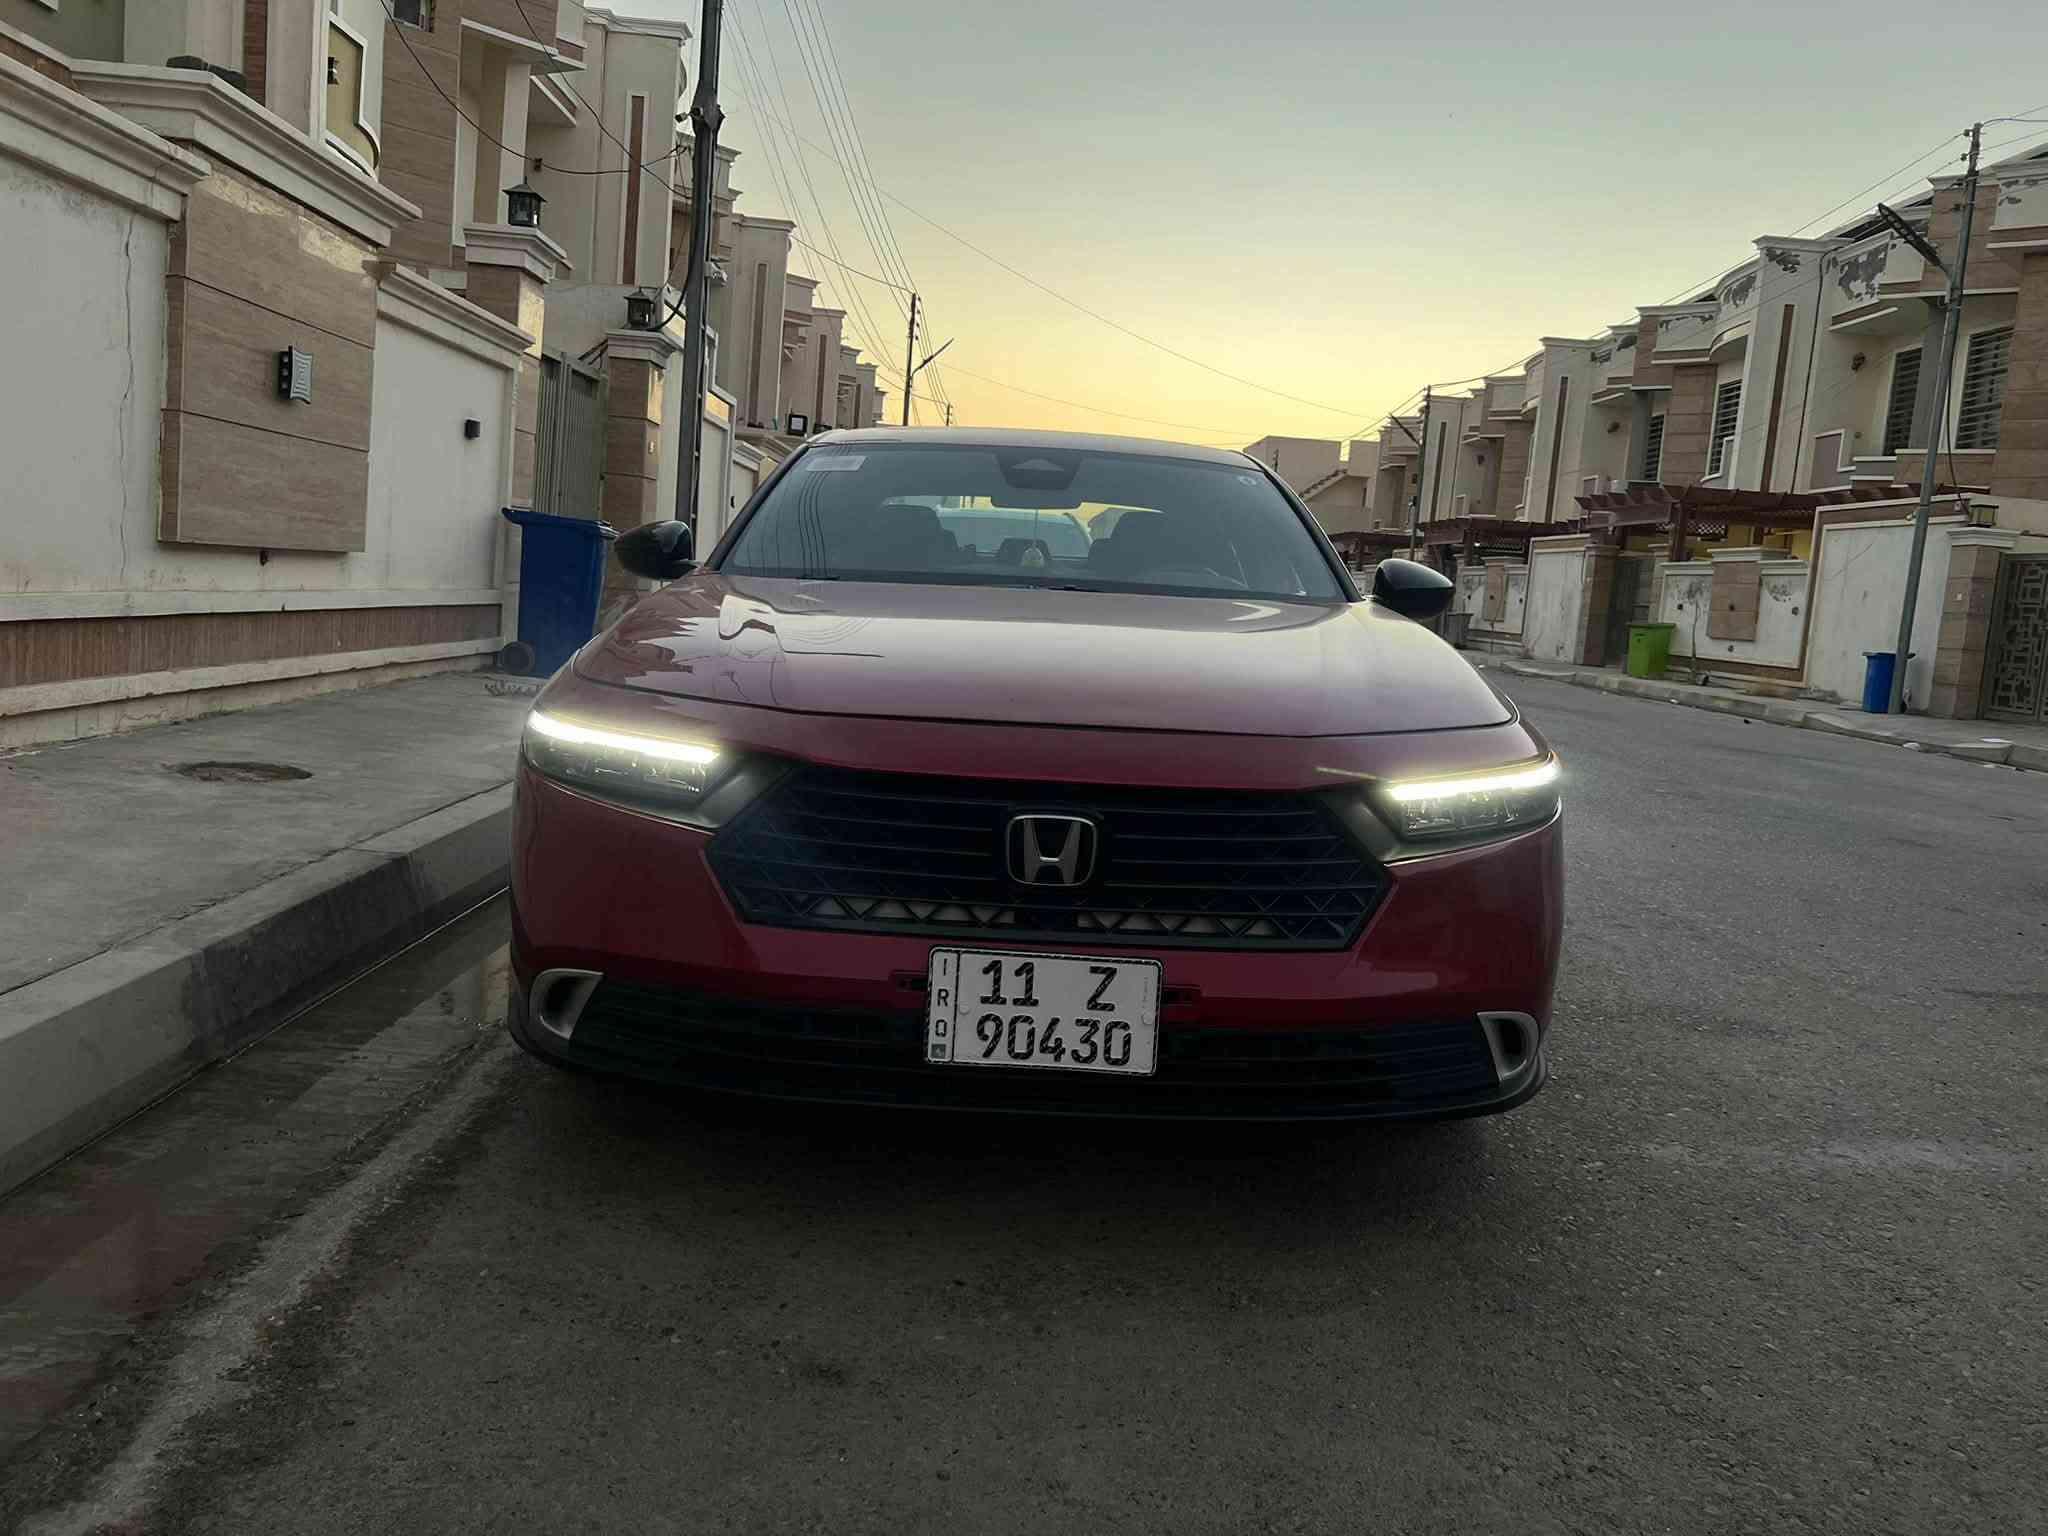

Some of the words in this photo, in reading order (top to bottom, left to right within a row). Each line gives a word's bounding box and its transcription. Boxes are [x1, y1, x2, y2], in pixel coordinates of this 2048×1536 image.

[980, 959, 1039, 1007] 11
[1086, 965, 1118, 1012] Z
[976, 1013, 1132, 1066] 90430
